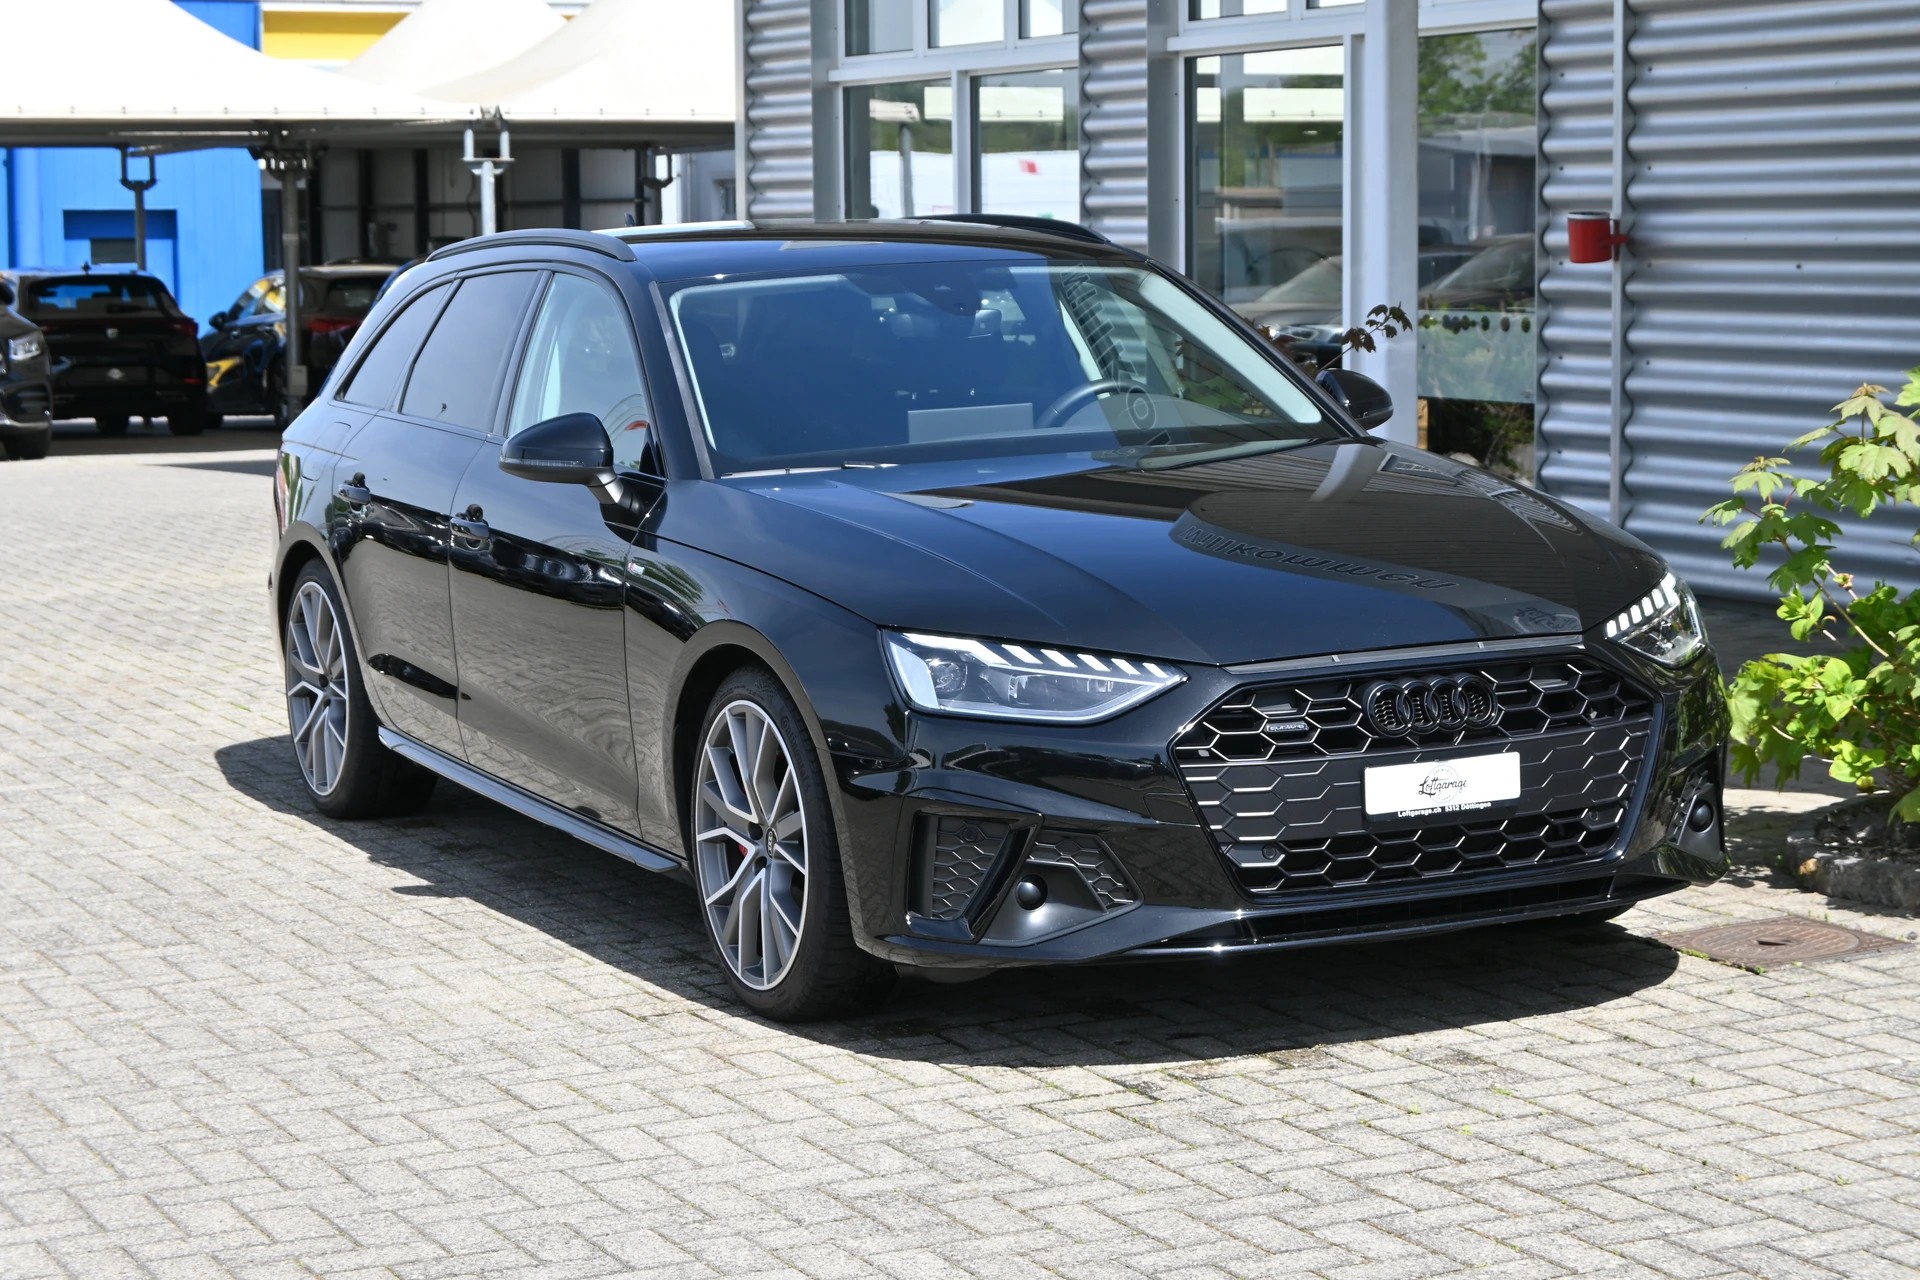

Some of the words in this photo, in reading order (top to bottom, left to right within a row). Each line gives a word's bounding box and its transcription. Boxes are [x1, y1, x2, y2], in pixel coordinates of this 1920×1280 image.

[1418, 775, 1468, 798] Loftgarage
[1398, 807, 1441, 817] Loftgarage.ch
[1444, 804, 1460, 812] 5312
